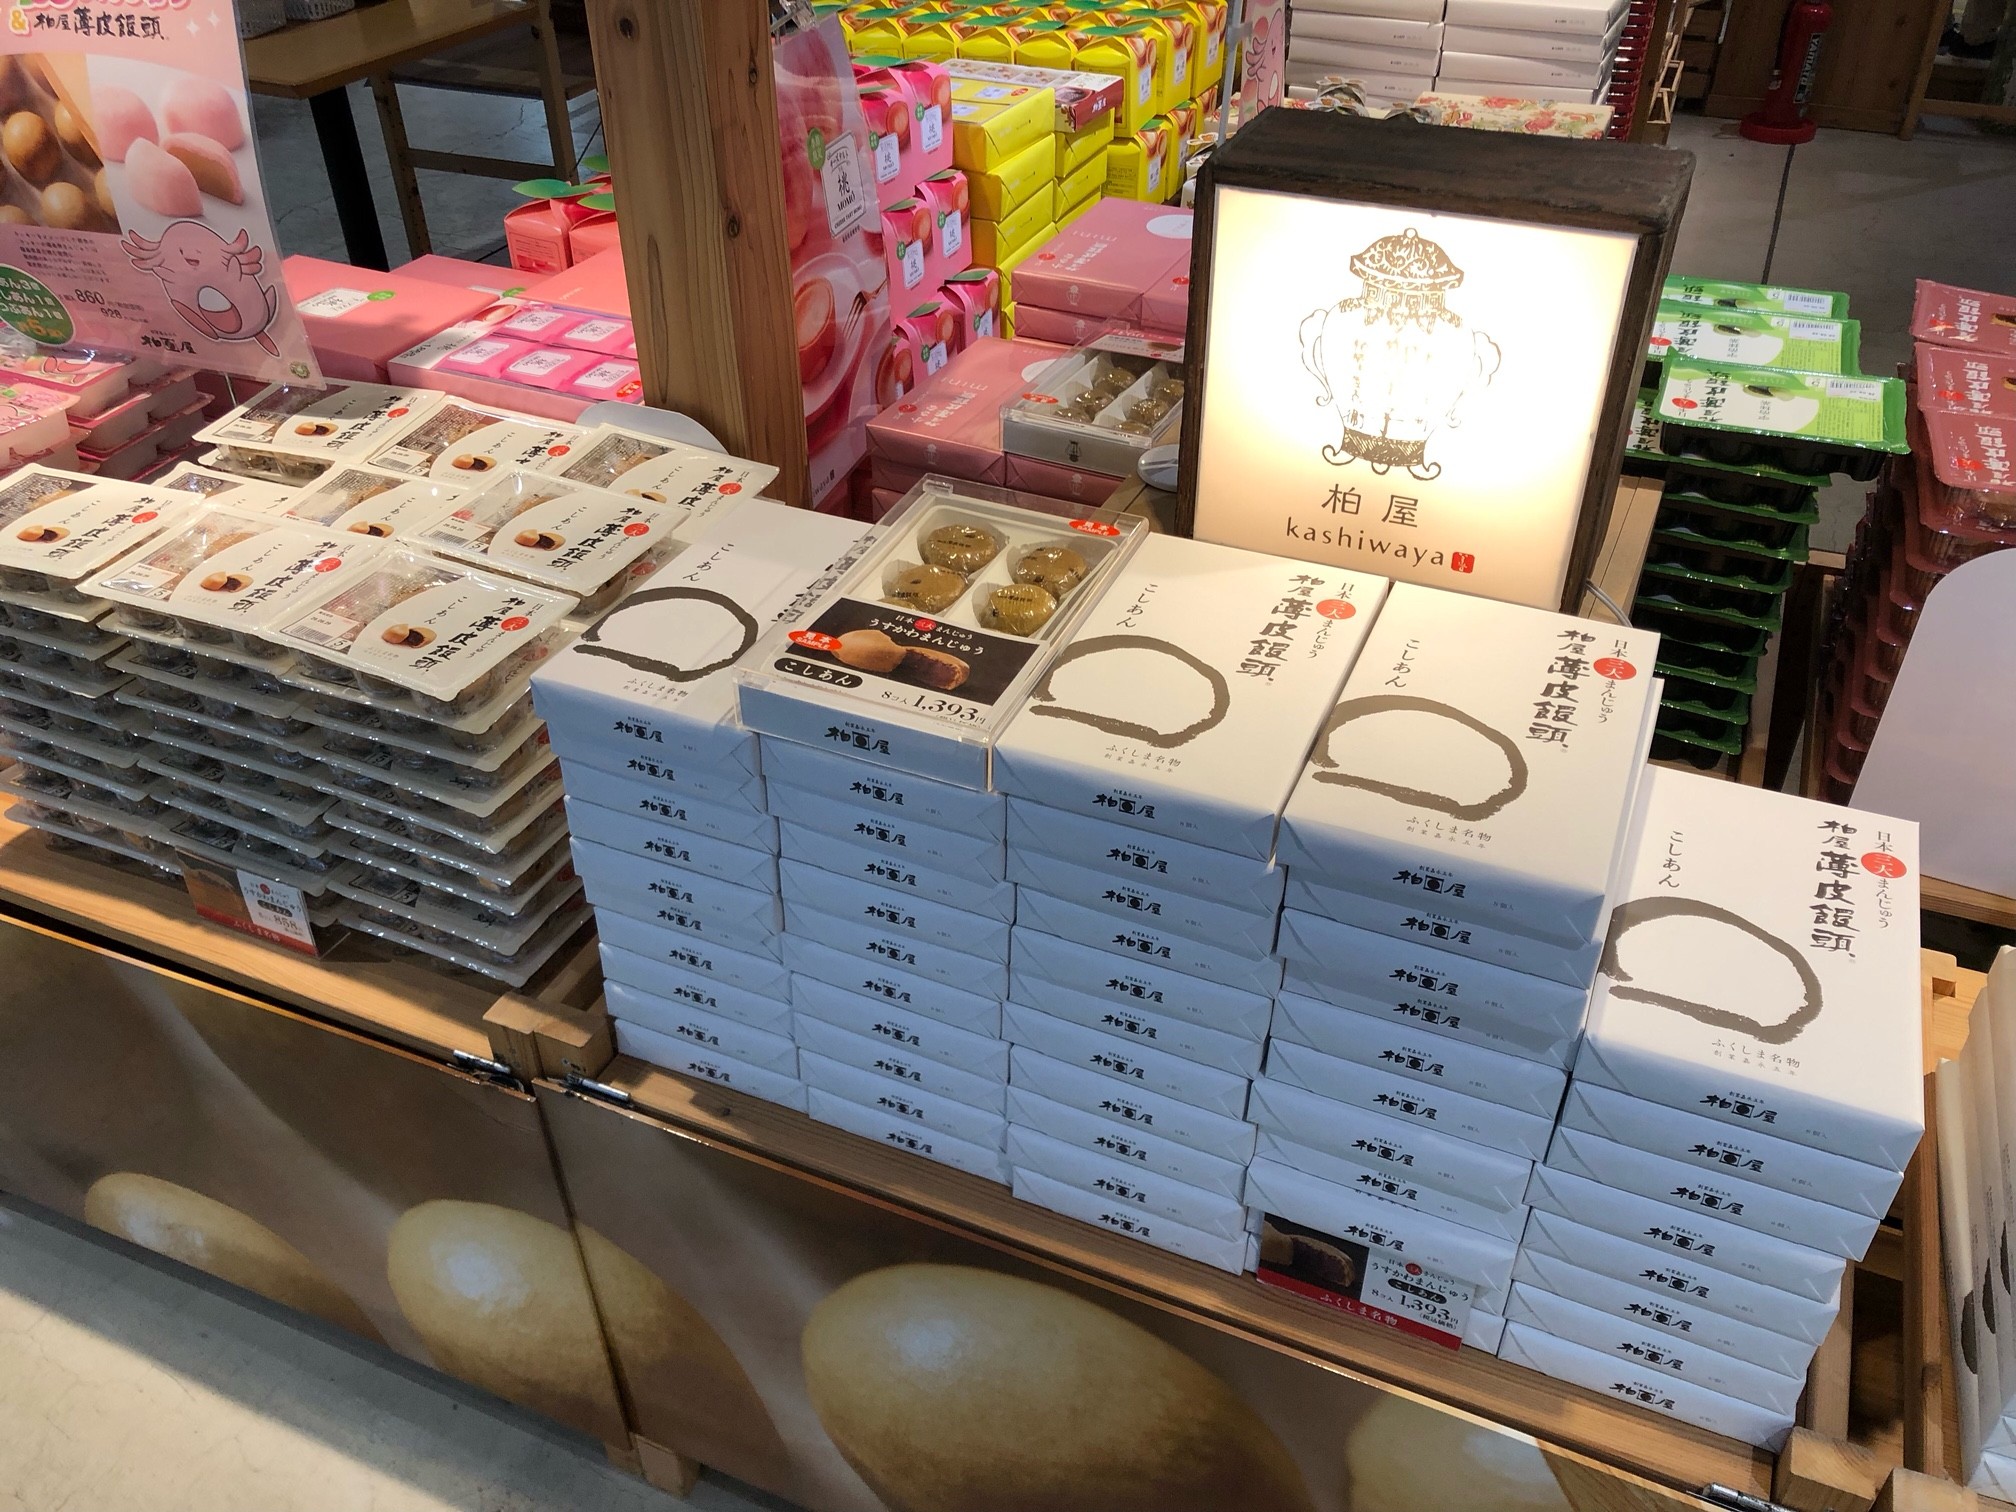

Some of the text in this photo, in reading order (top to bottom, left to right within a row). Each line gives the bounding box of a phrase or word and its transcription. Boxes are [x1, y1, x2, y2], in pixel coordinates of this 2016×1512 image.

[838, 171, 851, 197] 桃
[1321, 483, 1419, 528] 柏屋
[1286, 516, 1445, 568] kashiwaya
[682, 543, 734, 582] こしあん
[1117, 583, 1158, 628] こしあん
[795, 636, 832, 650] SAMPLE
[869, 618, 984, 655] うすかわまんじゅう
[784, 660, 852, 686] こしあん
[1384, 639, 1420, 688] こしあん
[913, 695, 986, 725] 1,393円
[1406, 816, 1492, 842] ふくしま名物
[1658, 830, 1684, 888] こしあん
[1711, 1039, 1800, 1069] ふくしま名物
[1371, 1261, 1469, 1301] うすかわまんじゅう
[1393, 1281, 1442, 1302] こしあん
[1320, 1294, 1398, 1326] ふくしま名物
